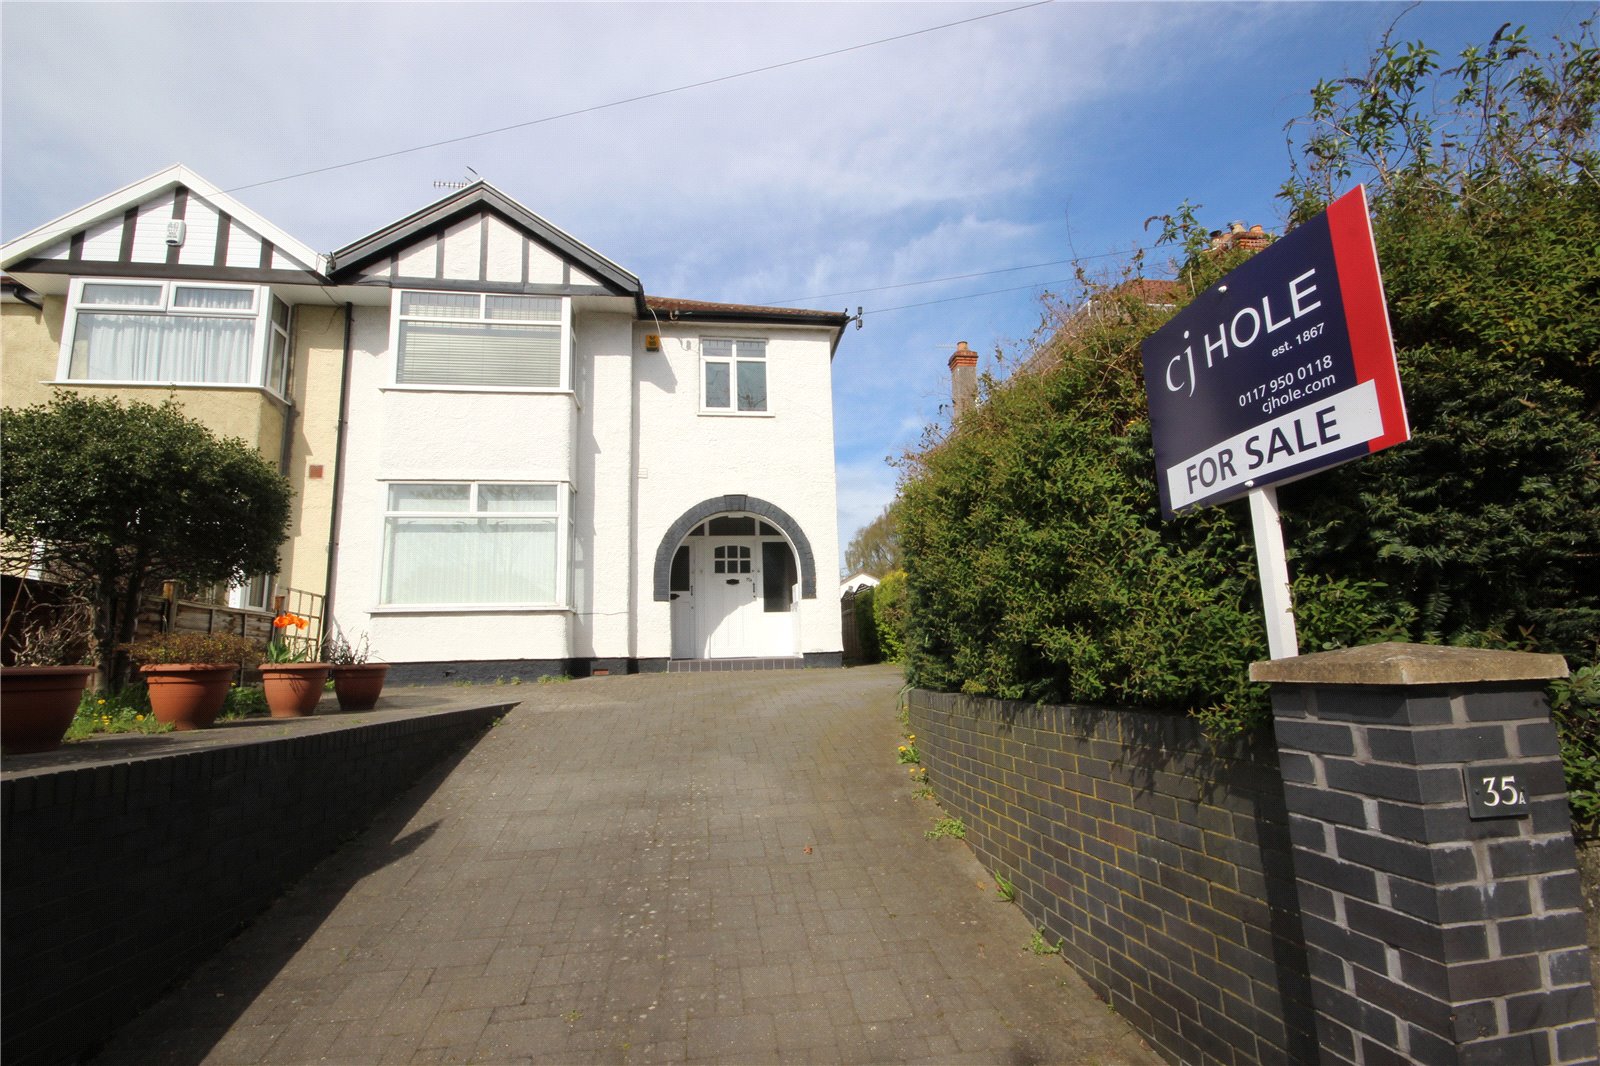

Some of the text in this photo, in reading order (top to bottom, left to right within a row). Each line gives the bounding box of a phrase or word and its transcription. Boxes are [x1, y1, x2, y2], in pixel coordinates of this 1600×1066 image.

[1203, 268, 1322, 368] HOLE
[1271, 322, 1325, 357] est. 1867
[1238, 355, 1333, 407] 0117 950 0118
[1262, 374, 1336, 415] cjhole.com
[1186, 405, 1341, 495] FOR SALE
